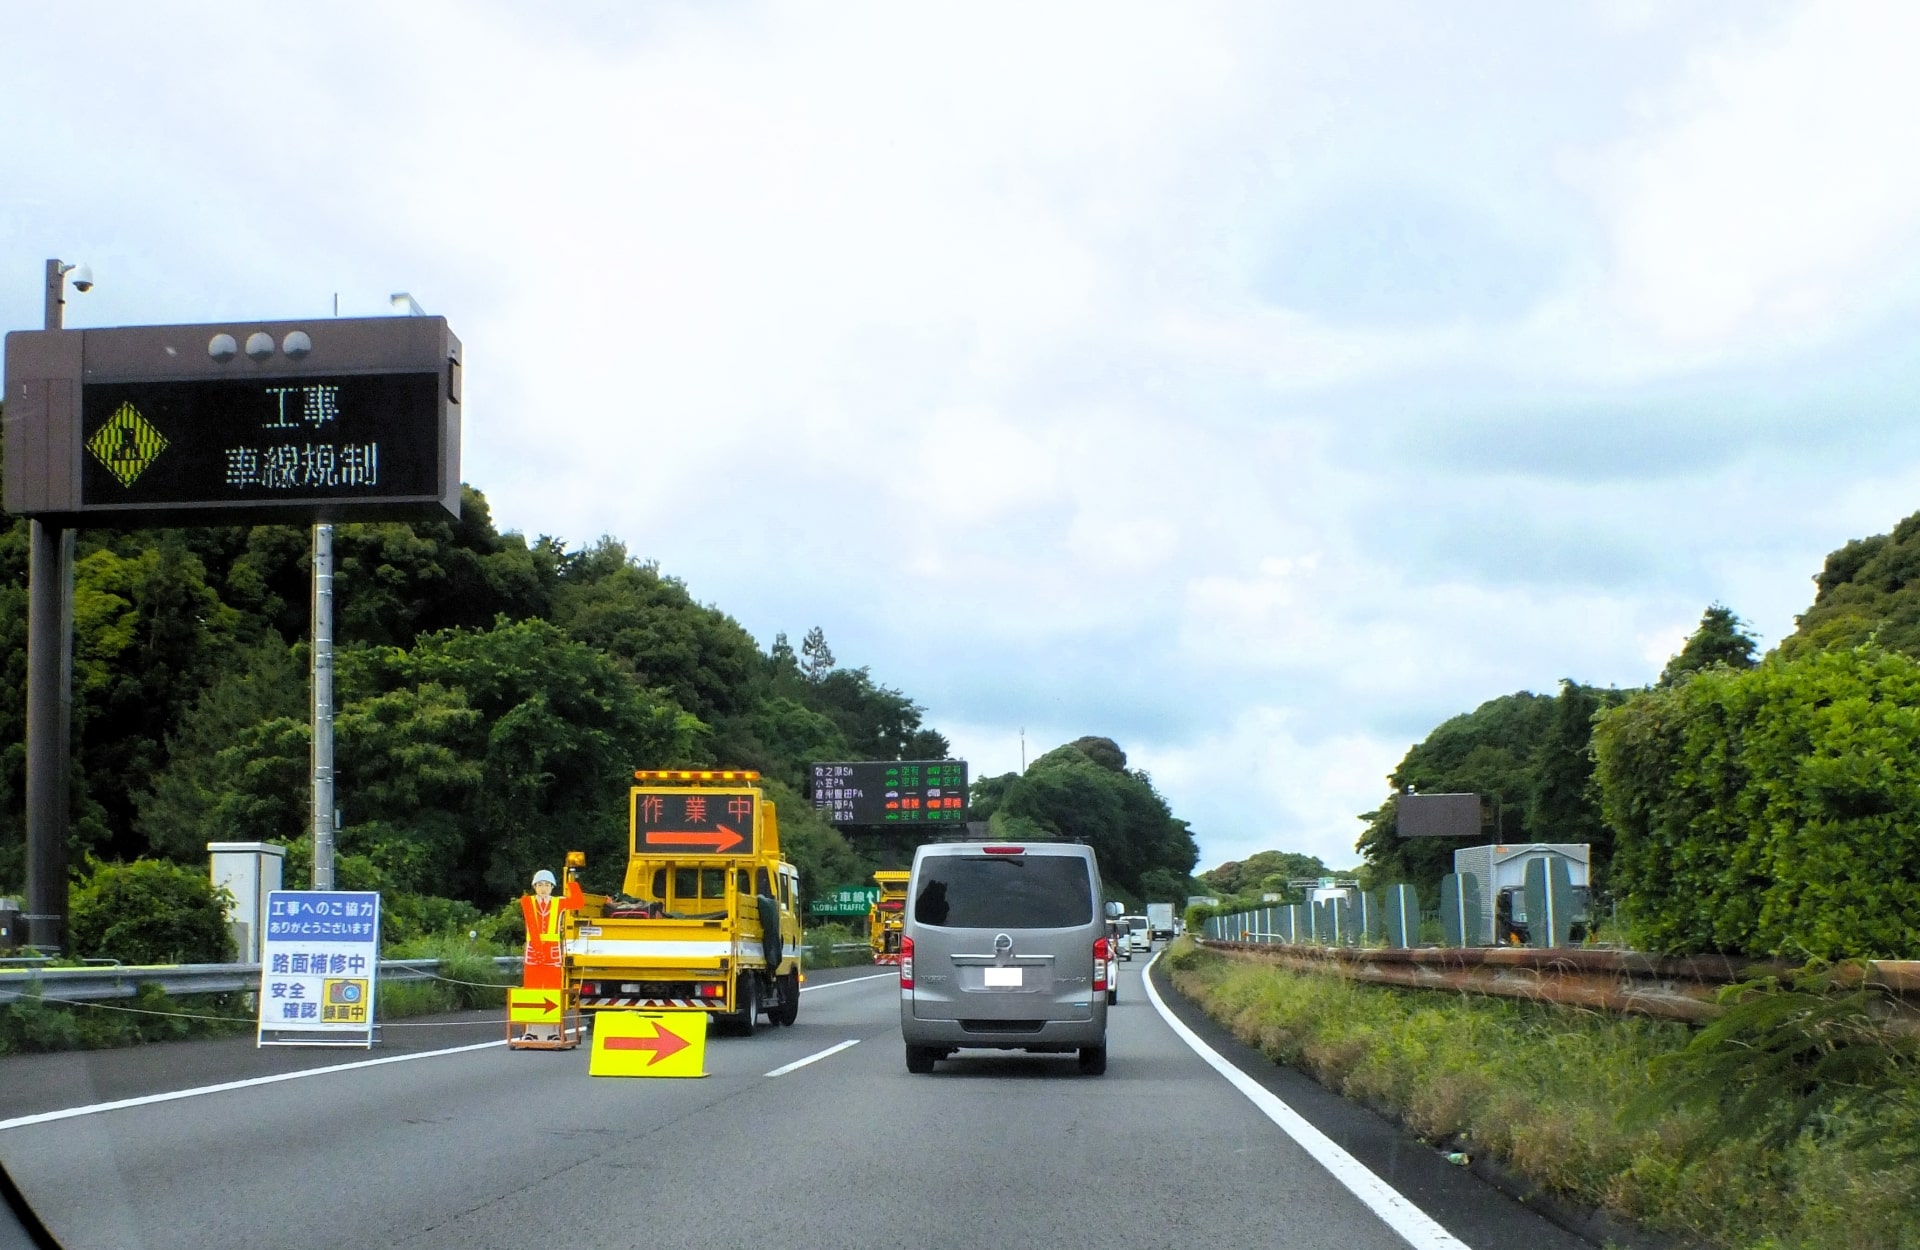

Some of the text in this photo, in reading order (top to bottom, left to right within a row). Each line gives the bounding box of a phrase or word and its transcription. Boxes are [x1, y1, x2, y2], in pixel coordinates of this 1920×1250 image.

[262, 384, 339, 429] 工事
[225, 442, 379, 489] 車線規制
[641, 796, 751, 824] 作業中
[271, 901, 373, 917] 工事へのご協力
[839, 903, 865, 911] TRAFFIC
[270, 921, 372, 935] ありがとうございます
[272, 953, 365, 974] 路面補修中
[271, 982, 305, 999] 安全
[283, 1002, 317, 1018] 確認
[323, 1005, 364, 1020] 録画中
